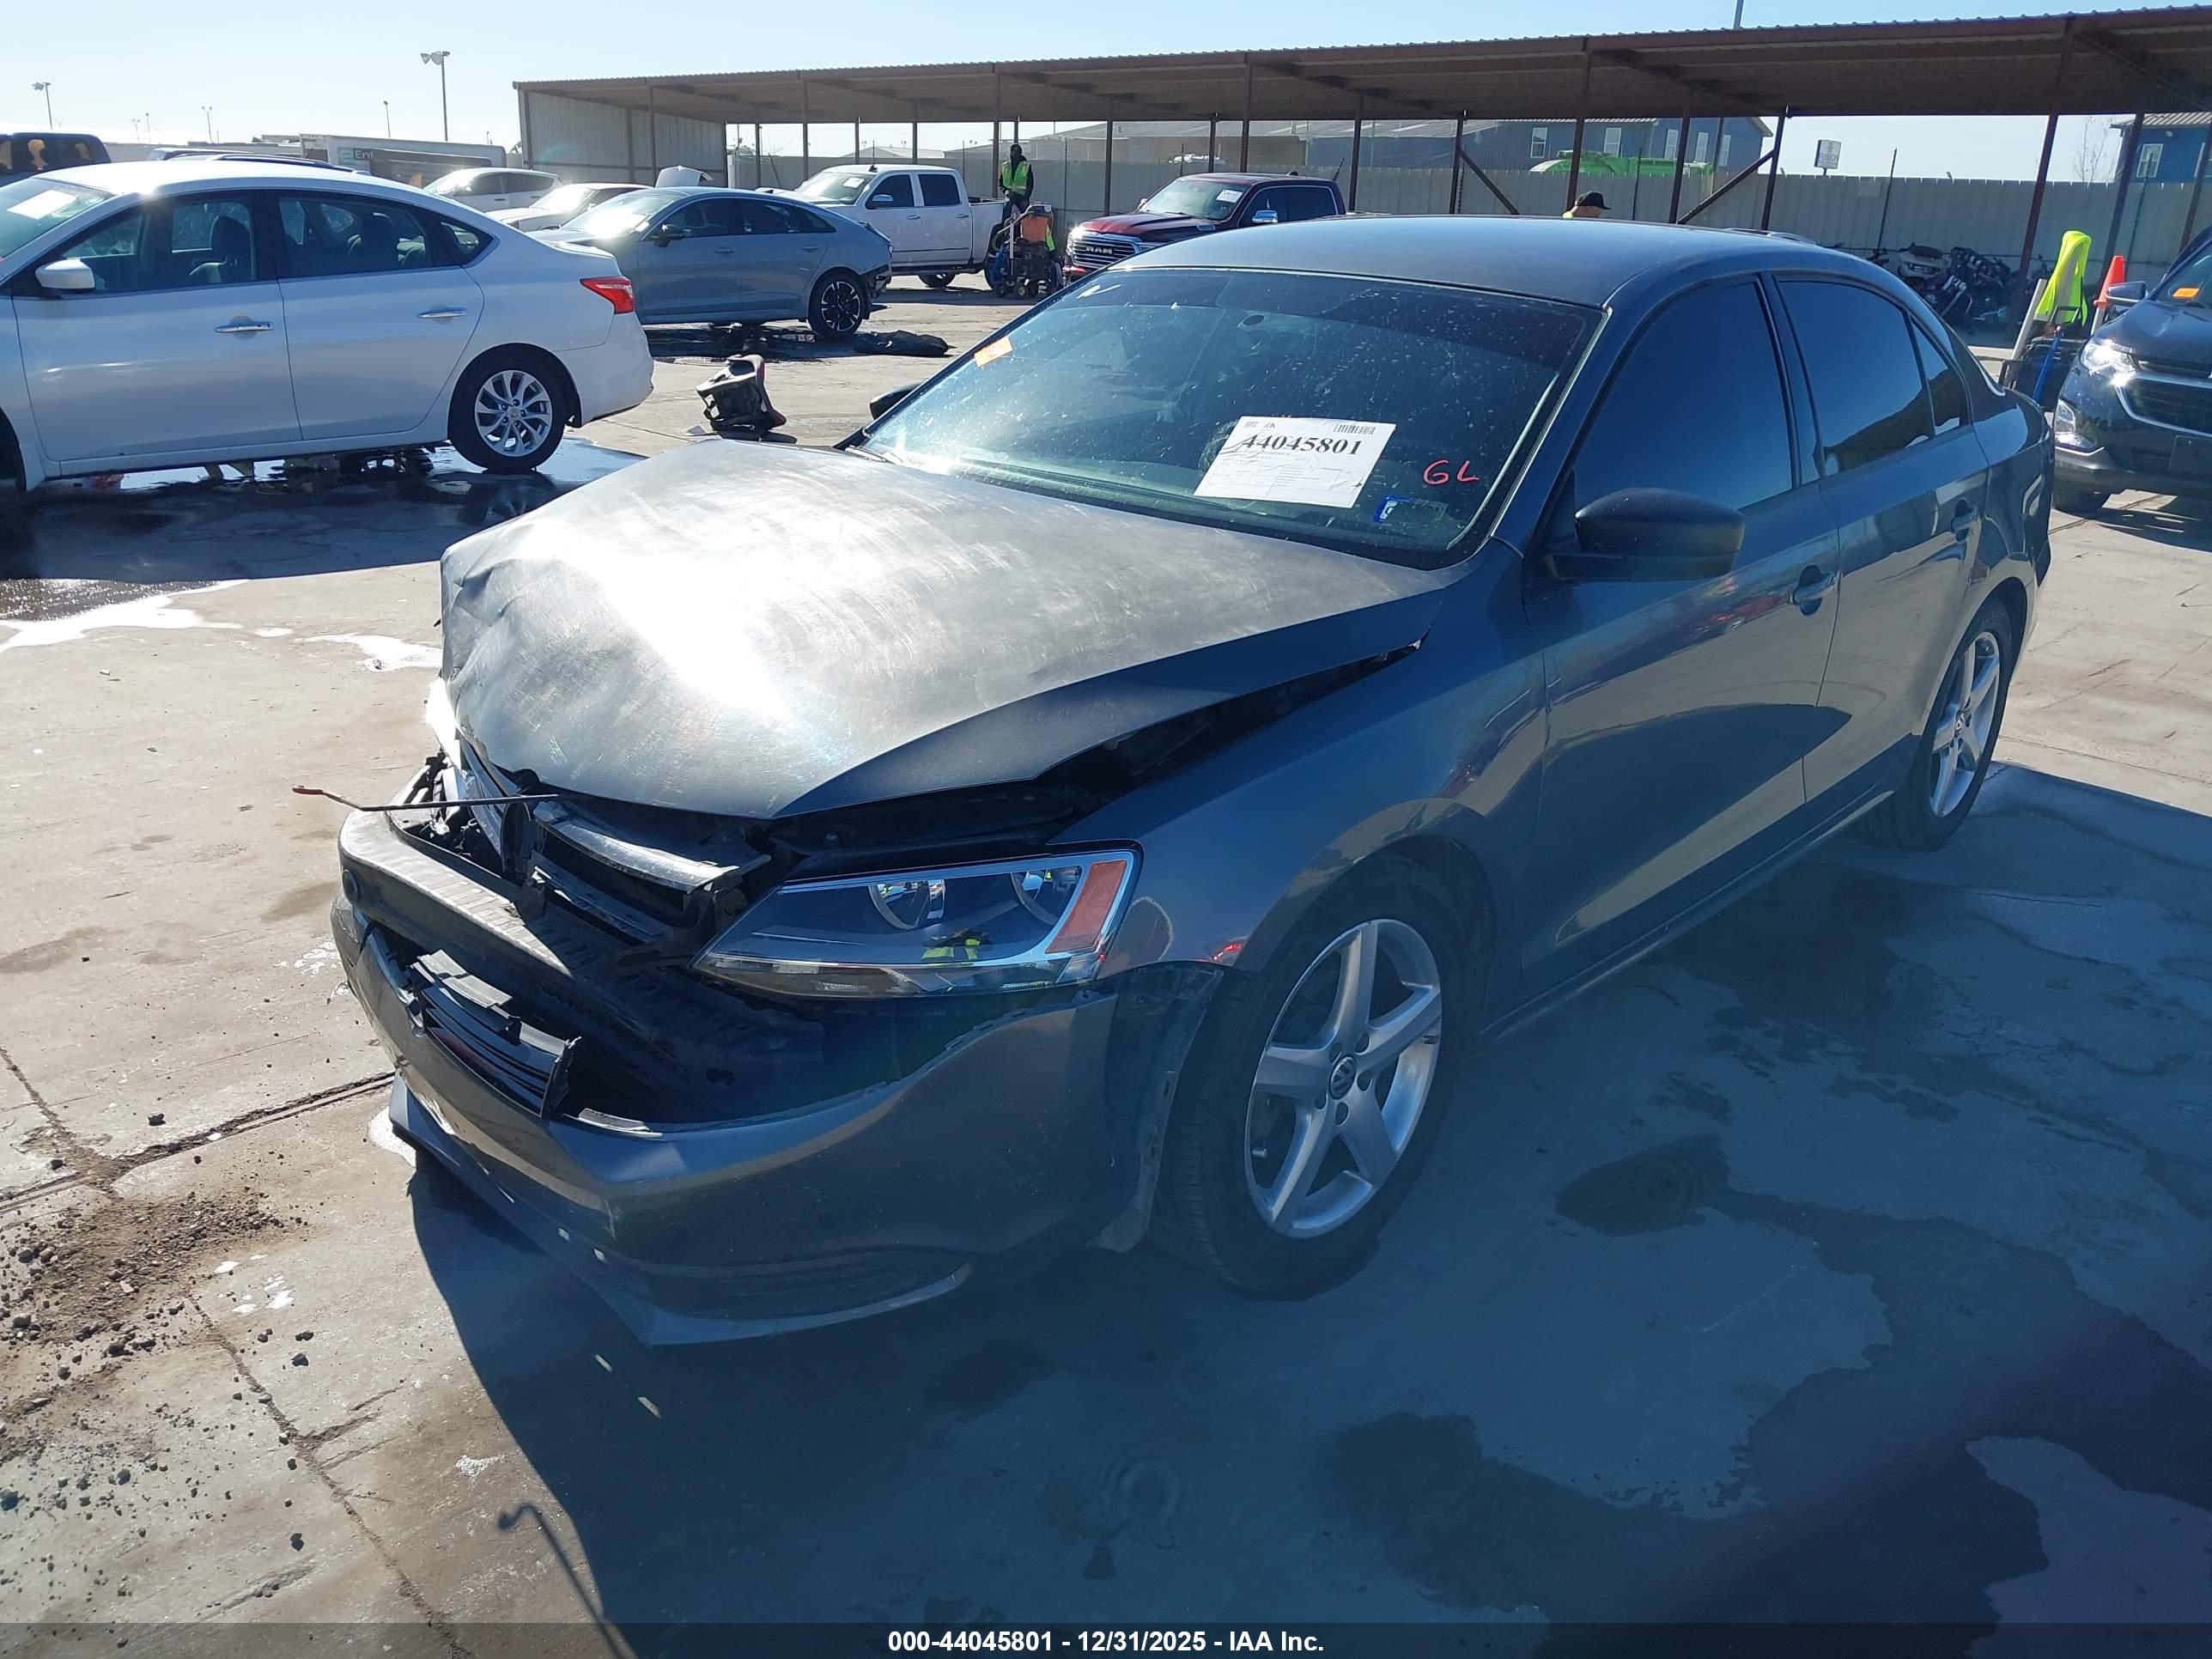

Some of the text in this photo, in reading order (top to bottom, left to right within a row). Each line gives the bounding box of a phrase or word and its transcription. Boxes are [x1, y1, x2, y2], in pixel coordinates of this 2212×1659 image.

[1085, 246, 1113, 254] RAM
[1241, 433, 1362, 455] 44045801
[1423, 459, 1480, 485] GL
